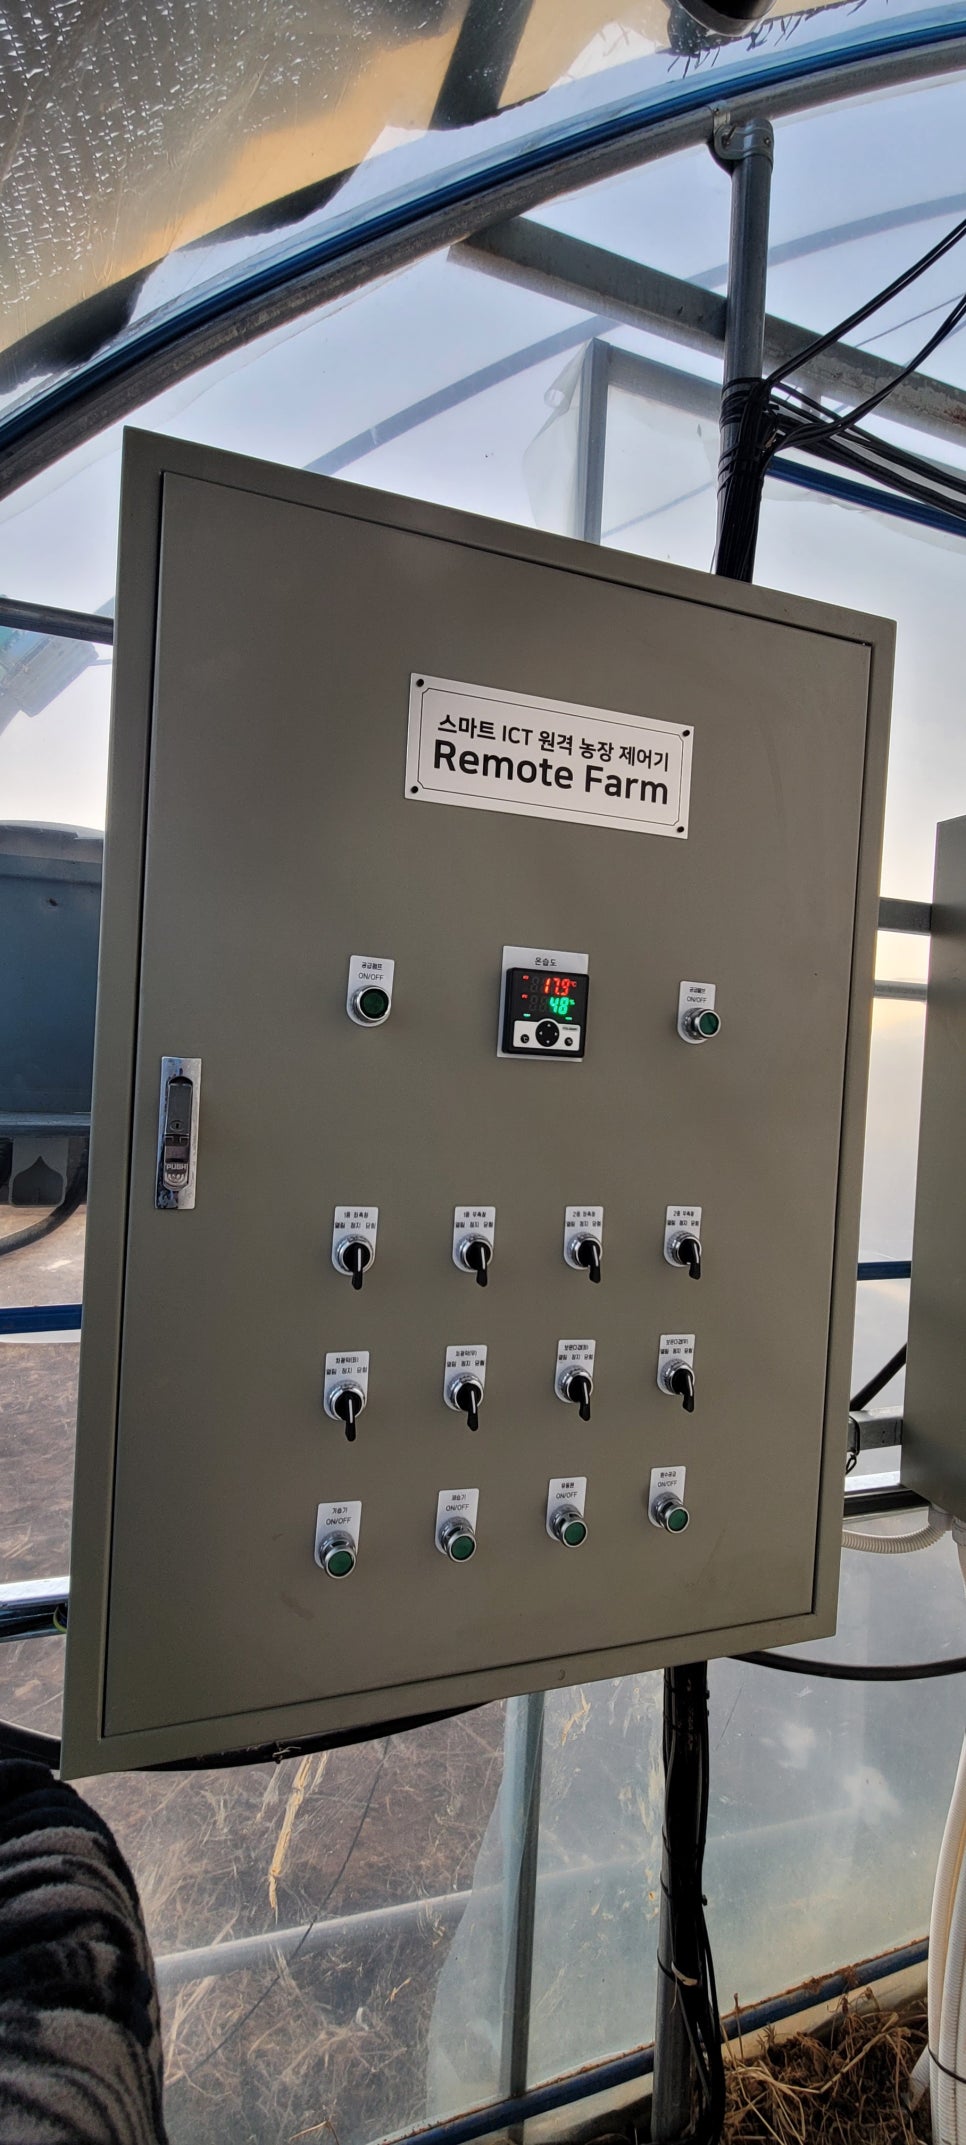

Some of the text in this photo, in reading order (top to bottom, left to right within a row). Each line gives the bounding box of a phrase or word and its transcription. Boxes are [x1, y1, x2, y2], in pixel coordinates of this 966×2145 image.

[437, 714, 669, 772] 스마트 ICT 원격 농장 제어기
[433, 739, 669, 805] Remote Farm
[358, 972, 385, 981] ON/OFF
[445, 1503, 470, 1512] ON/OFF
[325, 1516, 353, 1526] ON/OFF
